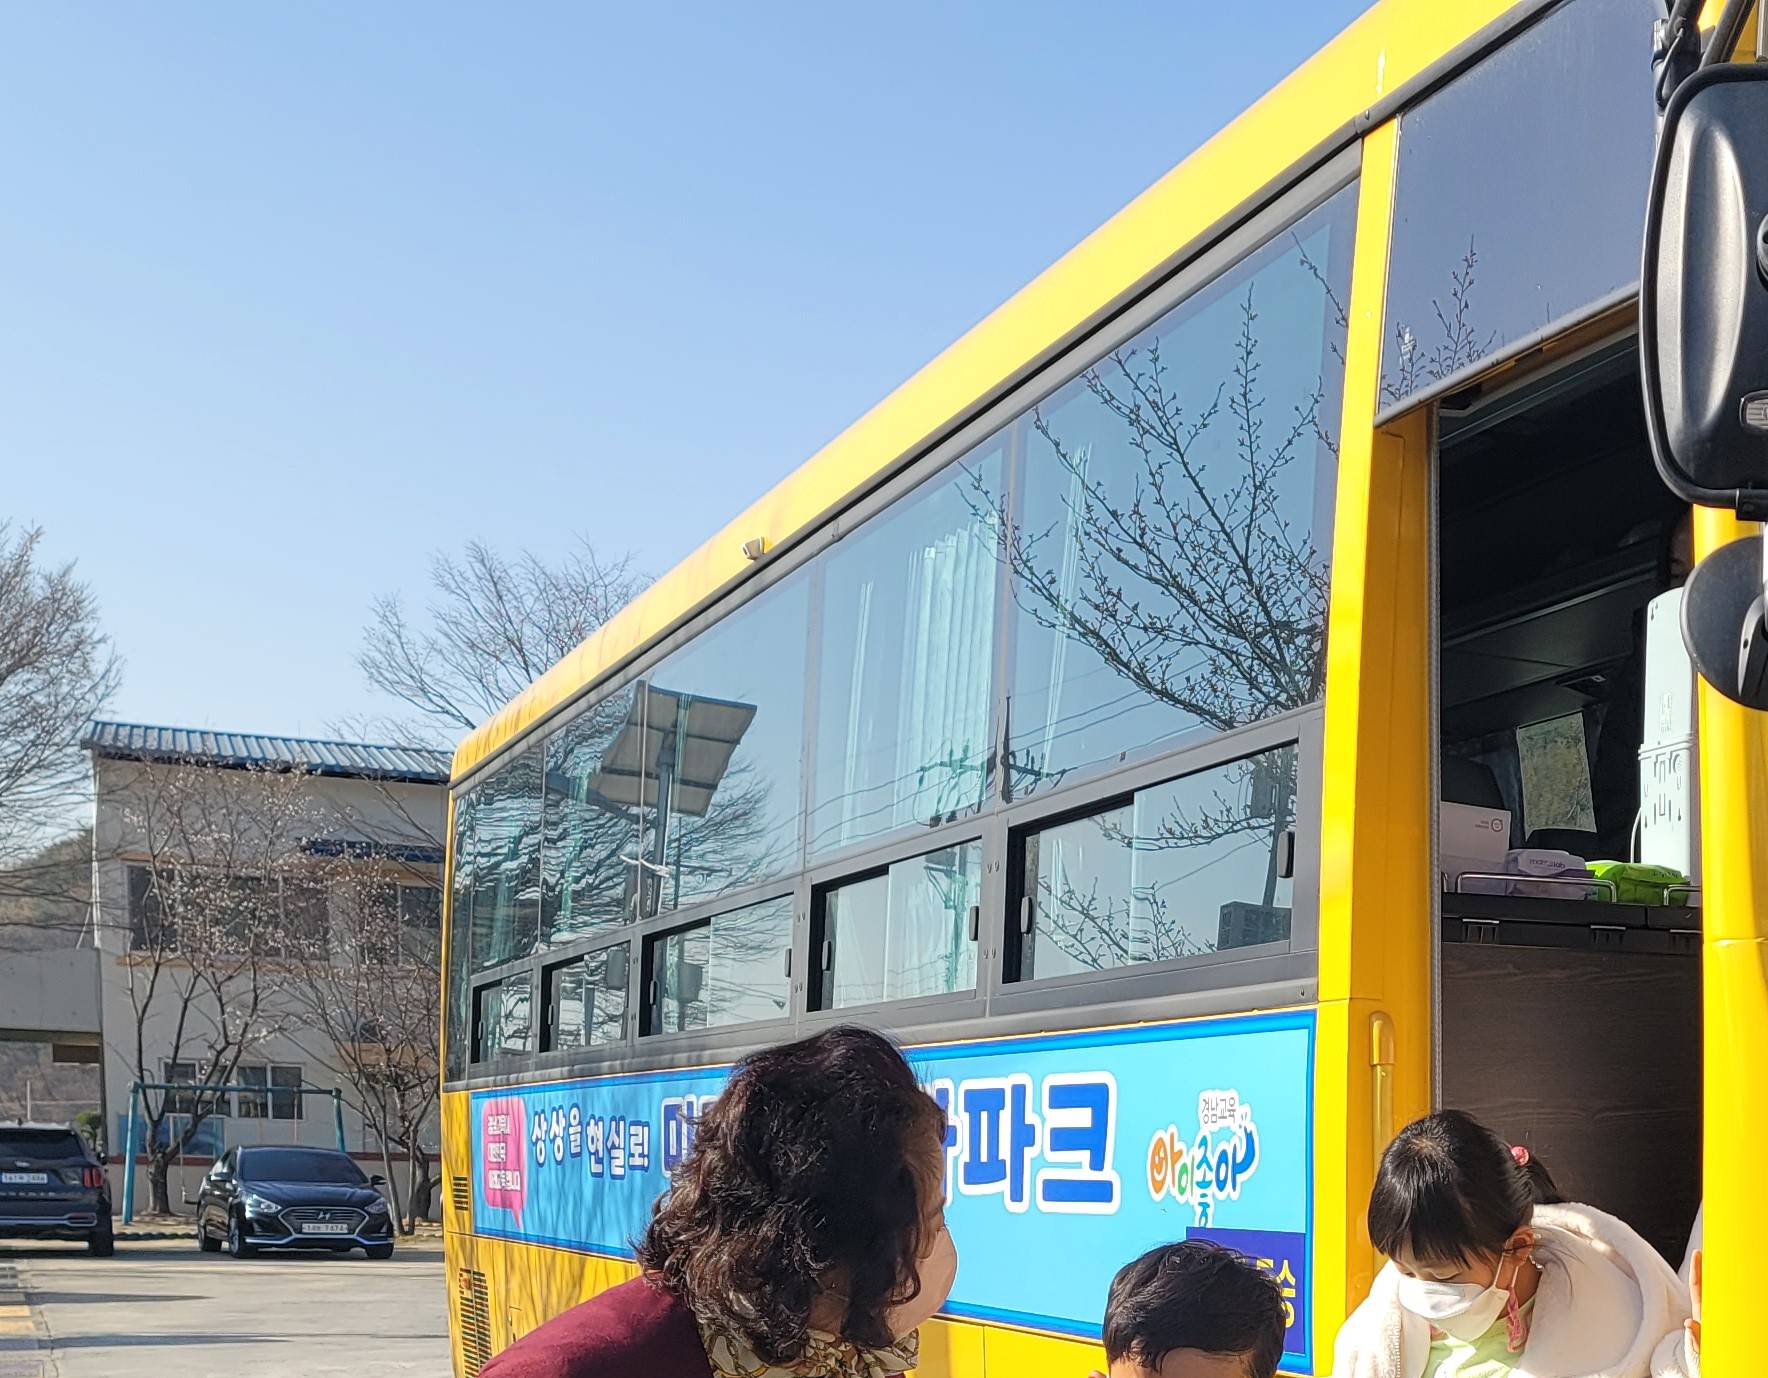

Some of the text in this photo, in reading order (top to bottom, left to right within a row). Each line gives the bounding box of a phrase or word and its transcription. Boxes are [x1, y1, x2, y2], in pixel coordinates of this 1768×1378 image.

[1201, 1096, 1237, 1125] 경남교육
[531, 1104, 583, 1167] 상상을
[586, 1115, 650, 1179] 현실로!
